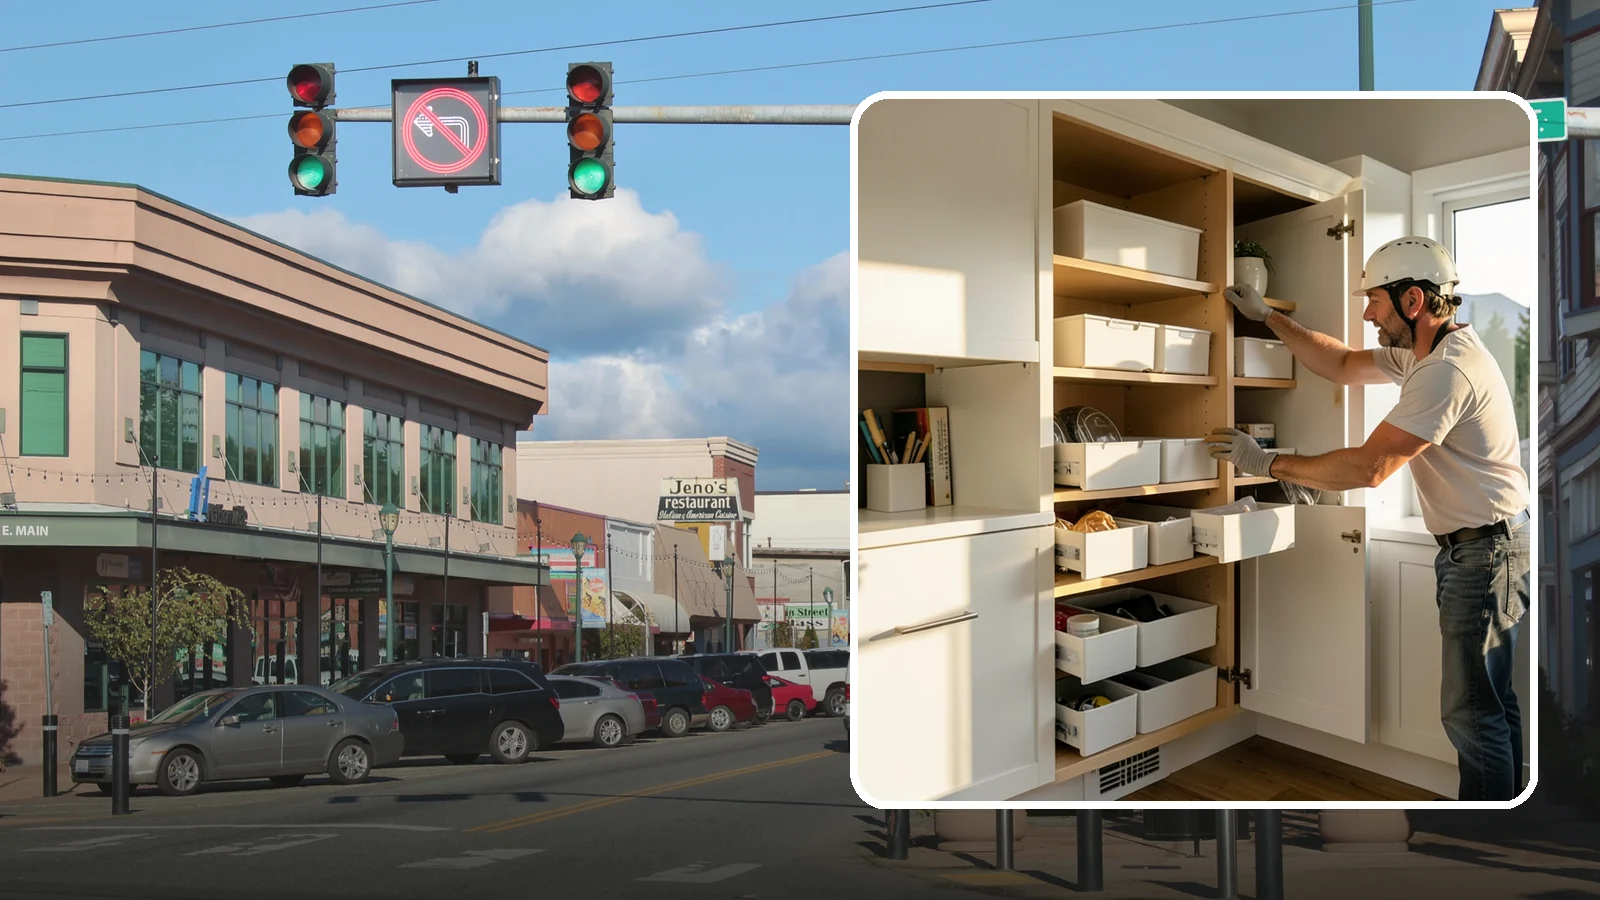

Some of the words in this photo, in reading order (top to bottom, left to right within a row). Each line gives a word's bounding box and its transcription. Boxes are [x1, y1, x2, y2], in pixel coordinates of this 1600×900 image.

[669, 480, 727, 494] Jeno's
[665, 496, 731, 509] restaurant
[658, 510, 682, 520] Italian
[686, 509, 714, 519] American
[715, 509, 737, 519] Cuisine
[2, 525, 13, 536] E.
[15, 525, 49, 536] MAIN
[797, 607, 828, 617] Street
